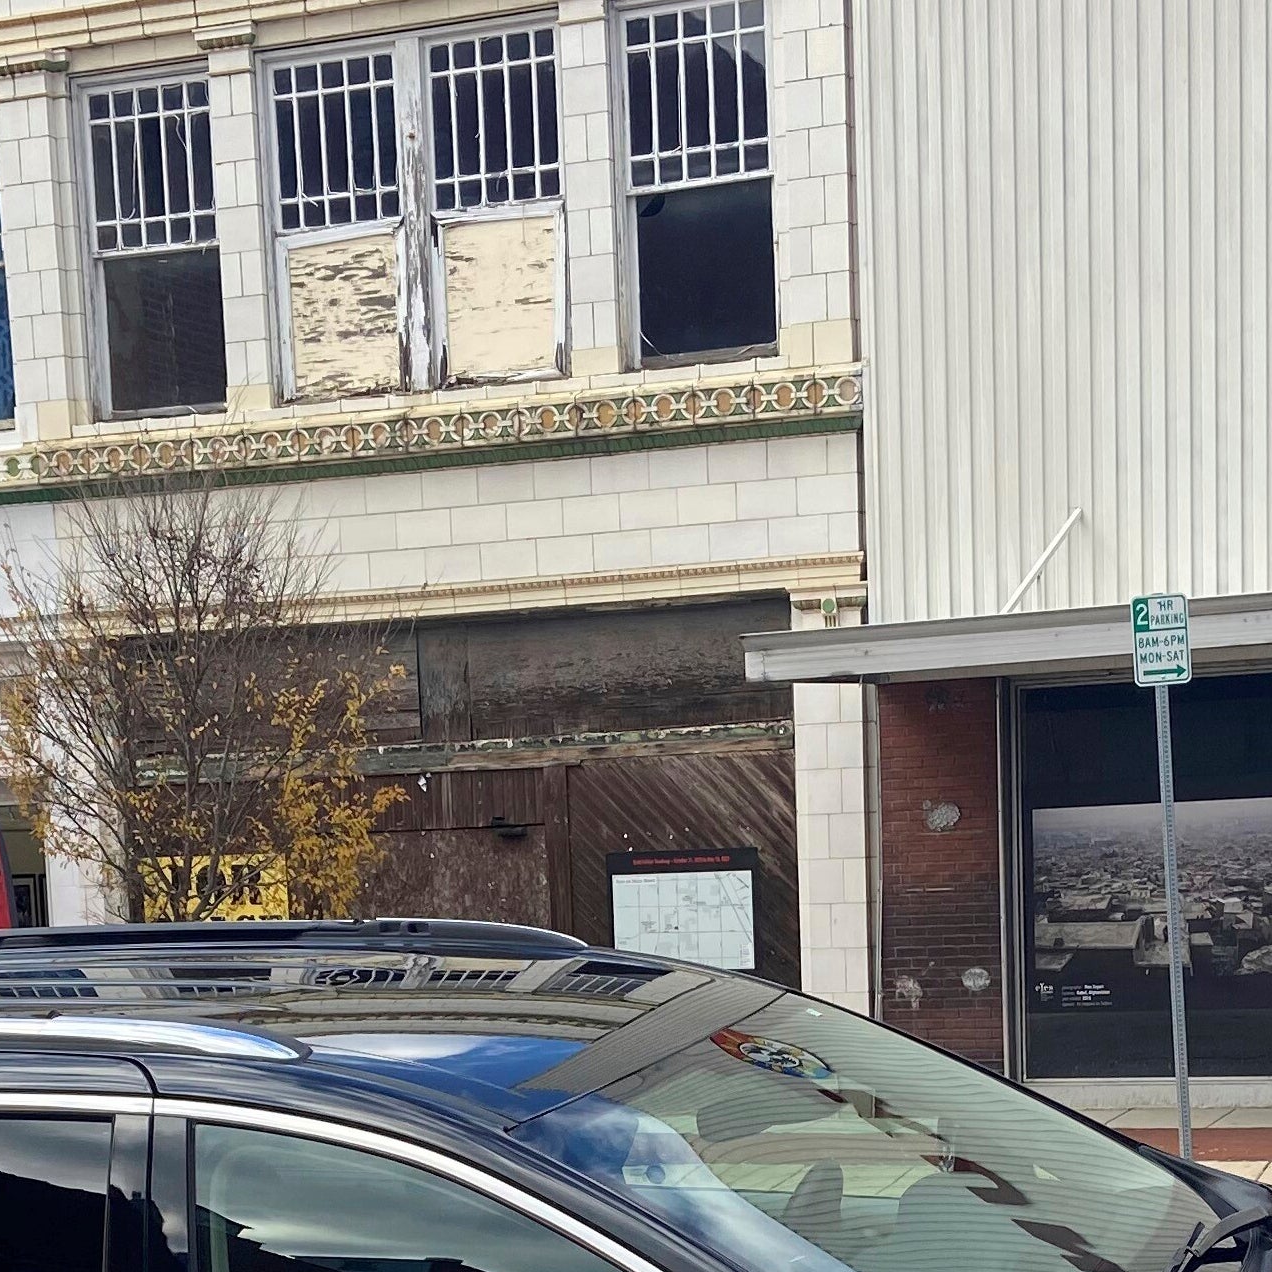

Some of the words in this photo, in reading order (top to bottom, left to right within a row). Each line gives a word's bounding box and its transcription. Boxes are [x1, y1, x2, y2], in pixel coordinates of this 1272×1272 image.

[1160, 599, 1173, 611] HR
[1135, 603, 1149, 626] 2
[1150, 612, 1184, 626] PARKING
[1138, 634, 1185, 648] 8AM-6PM
[1139, 649, 1185, 665] MON-SAT
